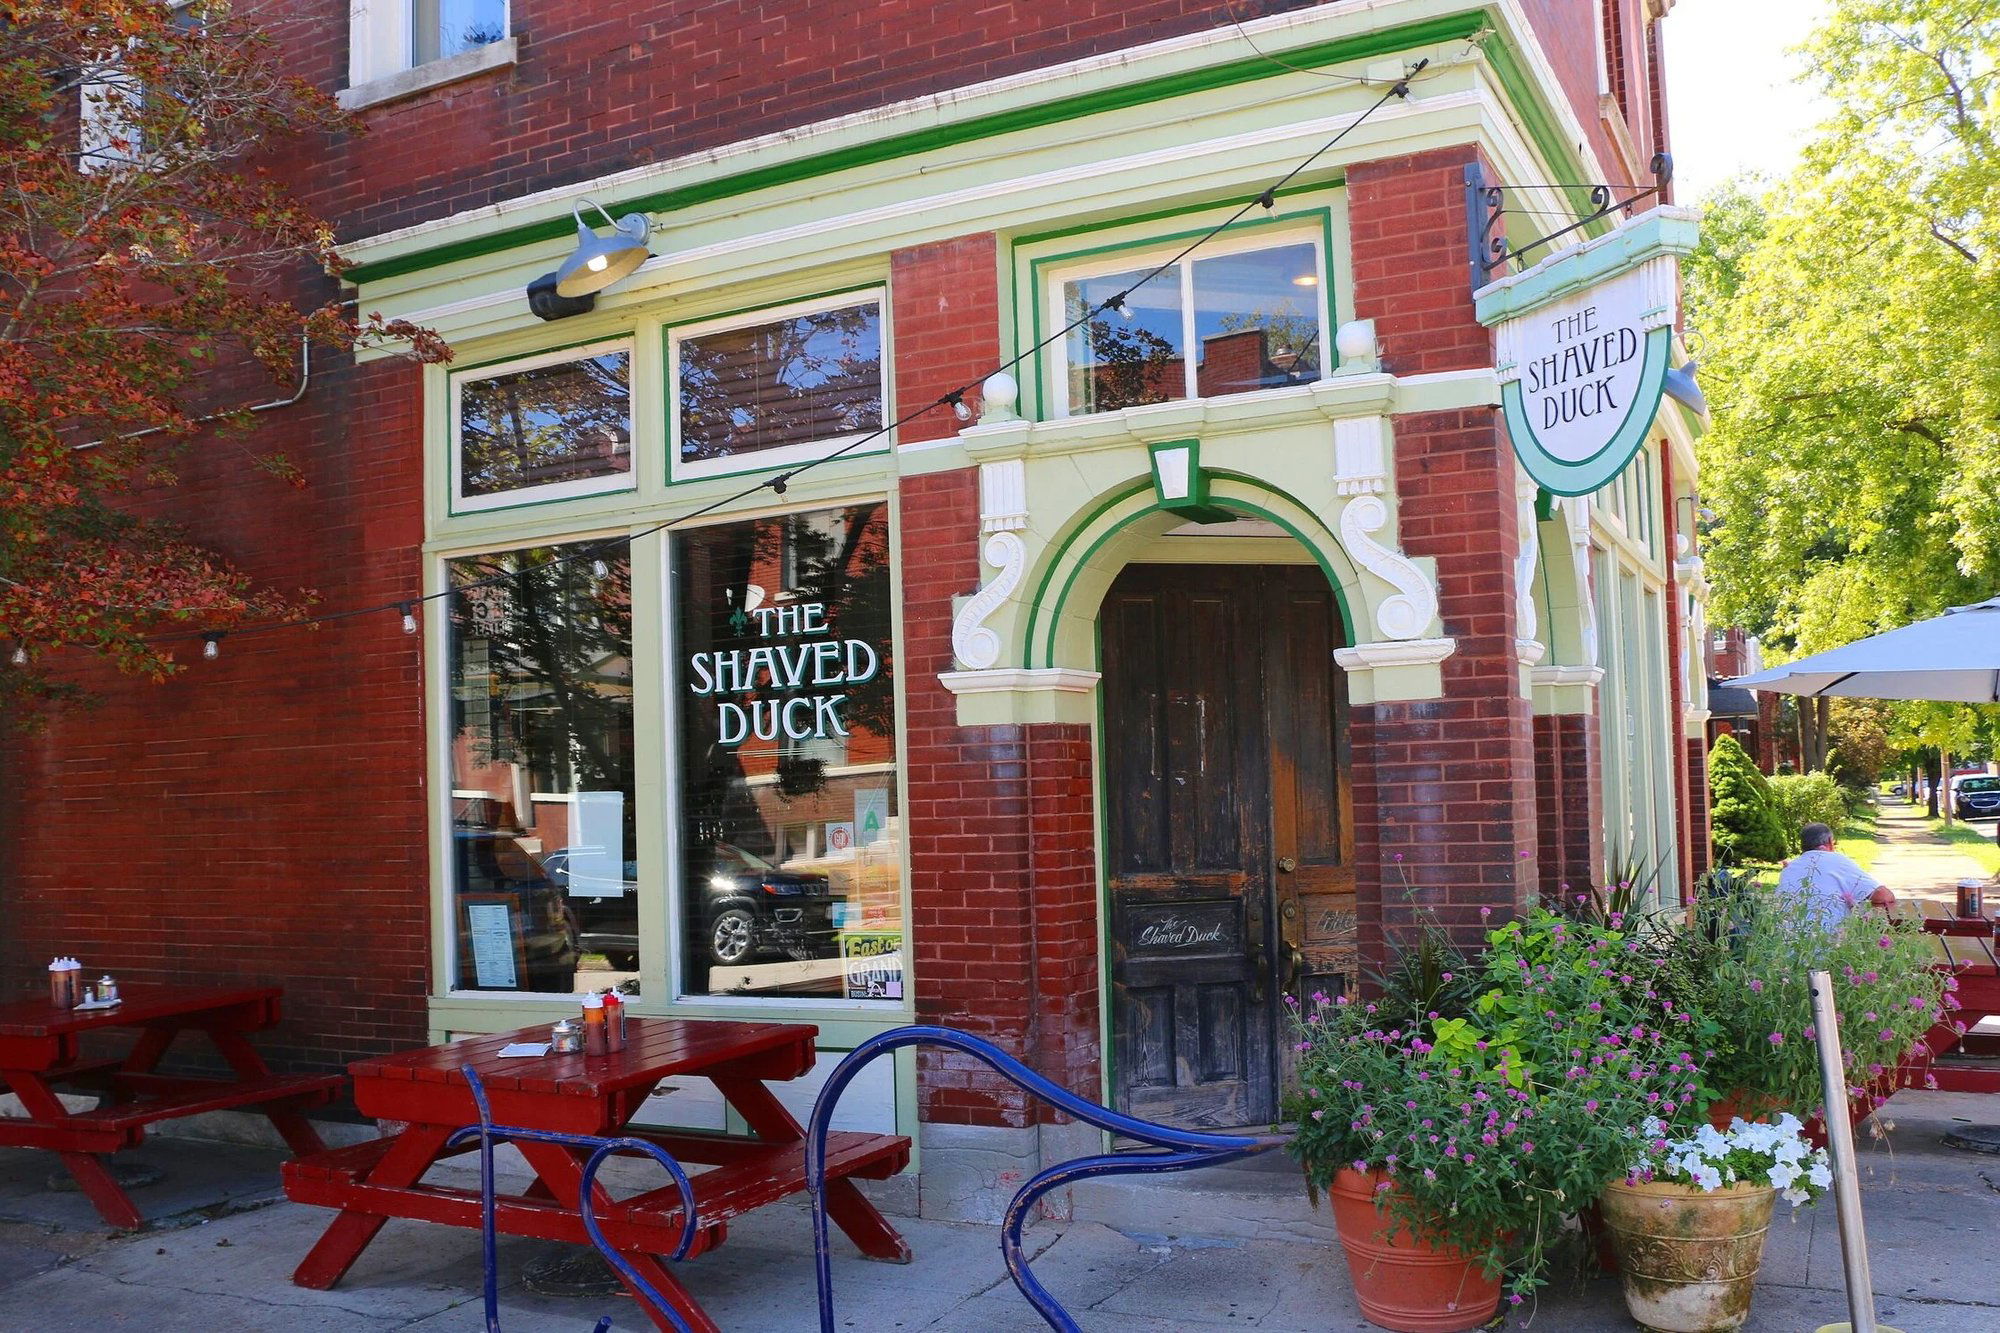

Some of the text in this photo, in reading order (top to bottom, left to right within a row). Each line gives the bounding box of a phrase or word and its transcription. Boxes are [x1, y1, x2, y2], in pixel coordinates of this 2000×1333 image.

[1551, 306, 1598, 343] THE
[1528, 327, 1637, 394] SHAVED
[1543, 376, 1618, 430] DUCK
[752, 602, 829, 638] THE
[690, 639, 879, 697] SHAVED
[717, 694, 850, 746] DUCK
[863, 809, 880, 832] A
[1138, 923, 1221, 945] Shaved Duck
[1161, 914, 1187, 932] The
[846, 936, 885, 960] East
[848, 957, 903, 986] GRAND
